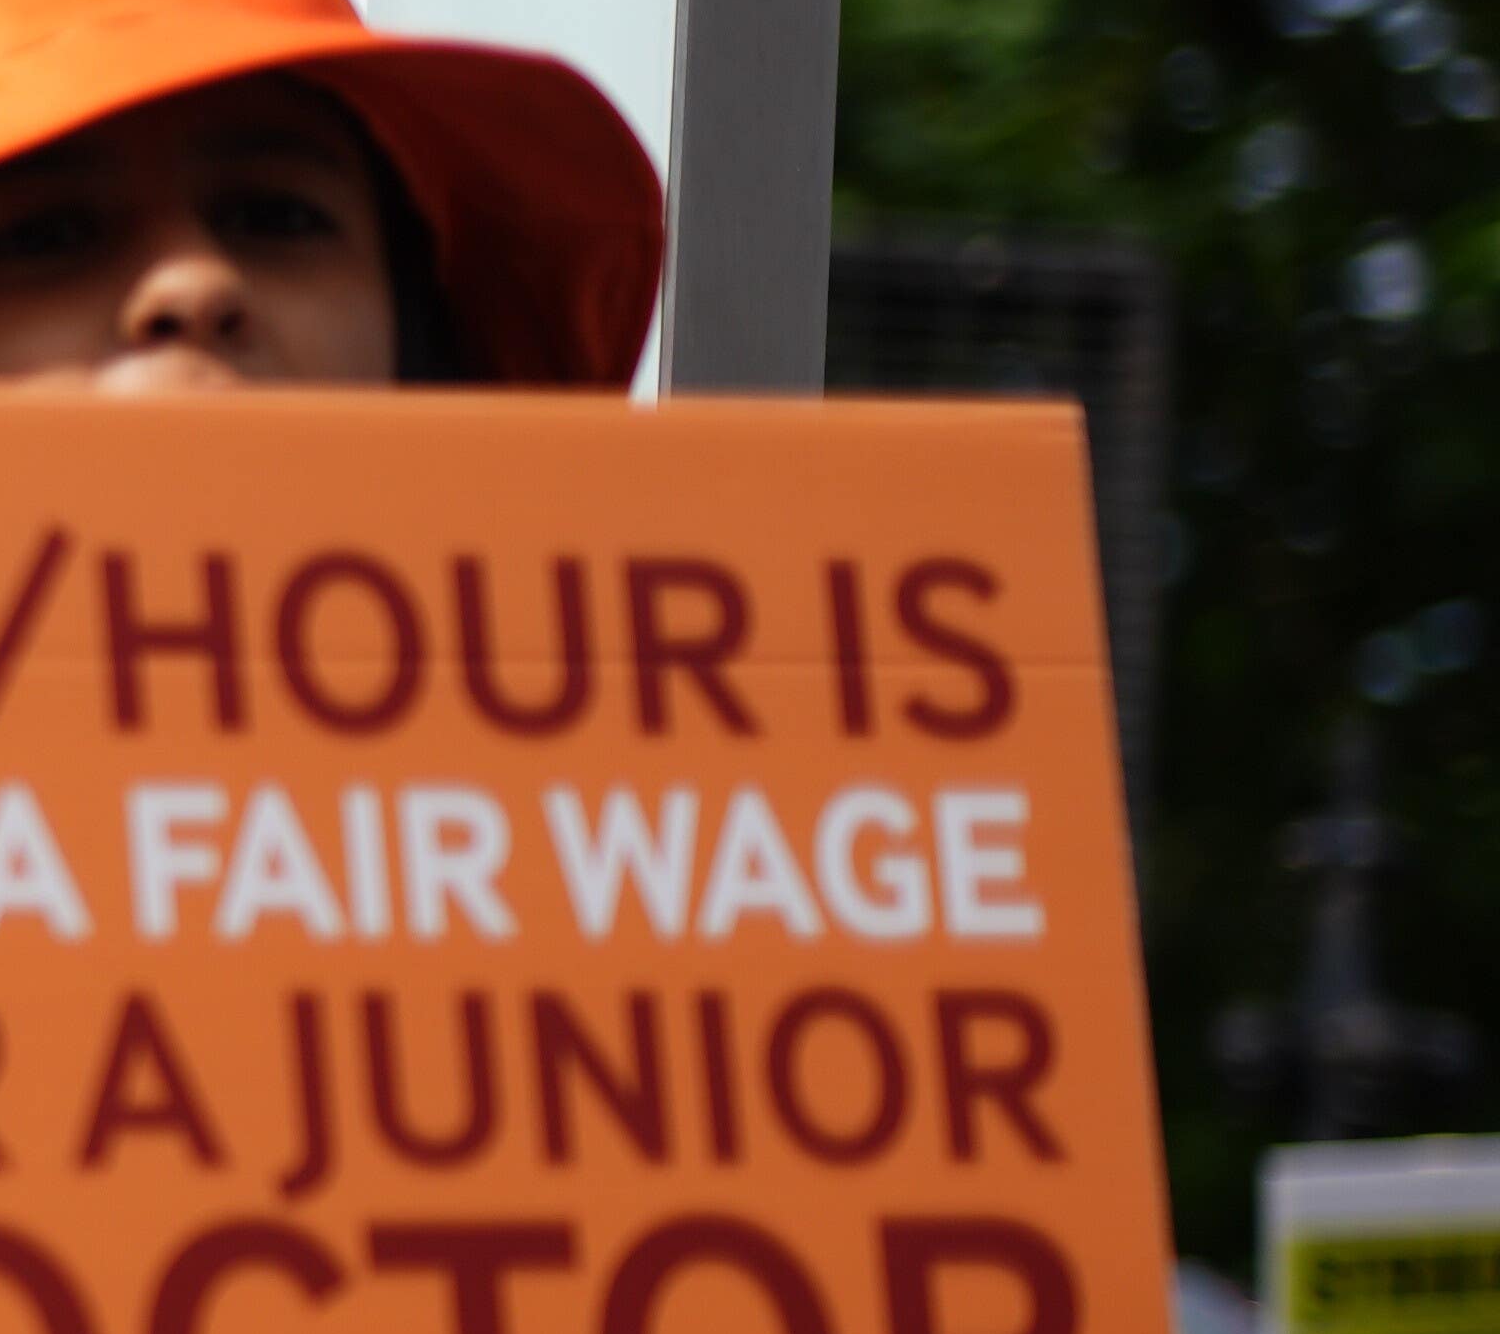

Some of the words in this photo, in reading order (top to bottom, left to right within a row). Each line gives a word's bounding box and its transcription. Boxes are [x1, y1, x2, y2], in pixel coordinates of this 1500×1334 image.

[825, 556, 1018, 742] IS
[125, 782, 515, 941] FAIR
[544, 785, 1044, 942] WAGE
[77, 989, 227, 1172] A
[277, 986, 1066, 1203] JUNIOR
